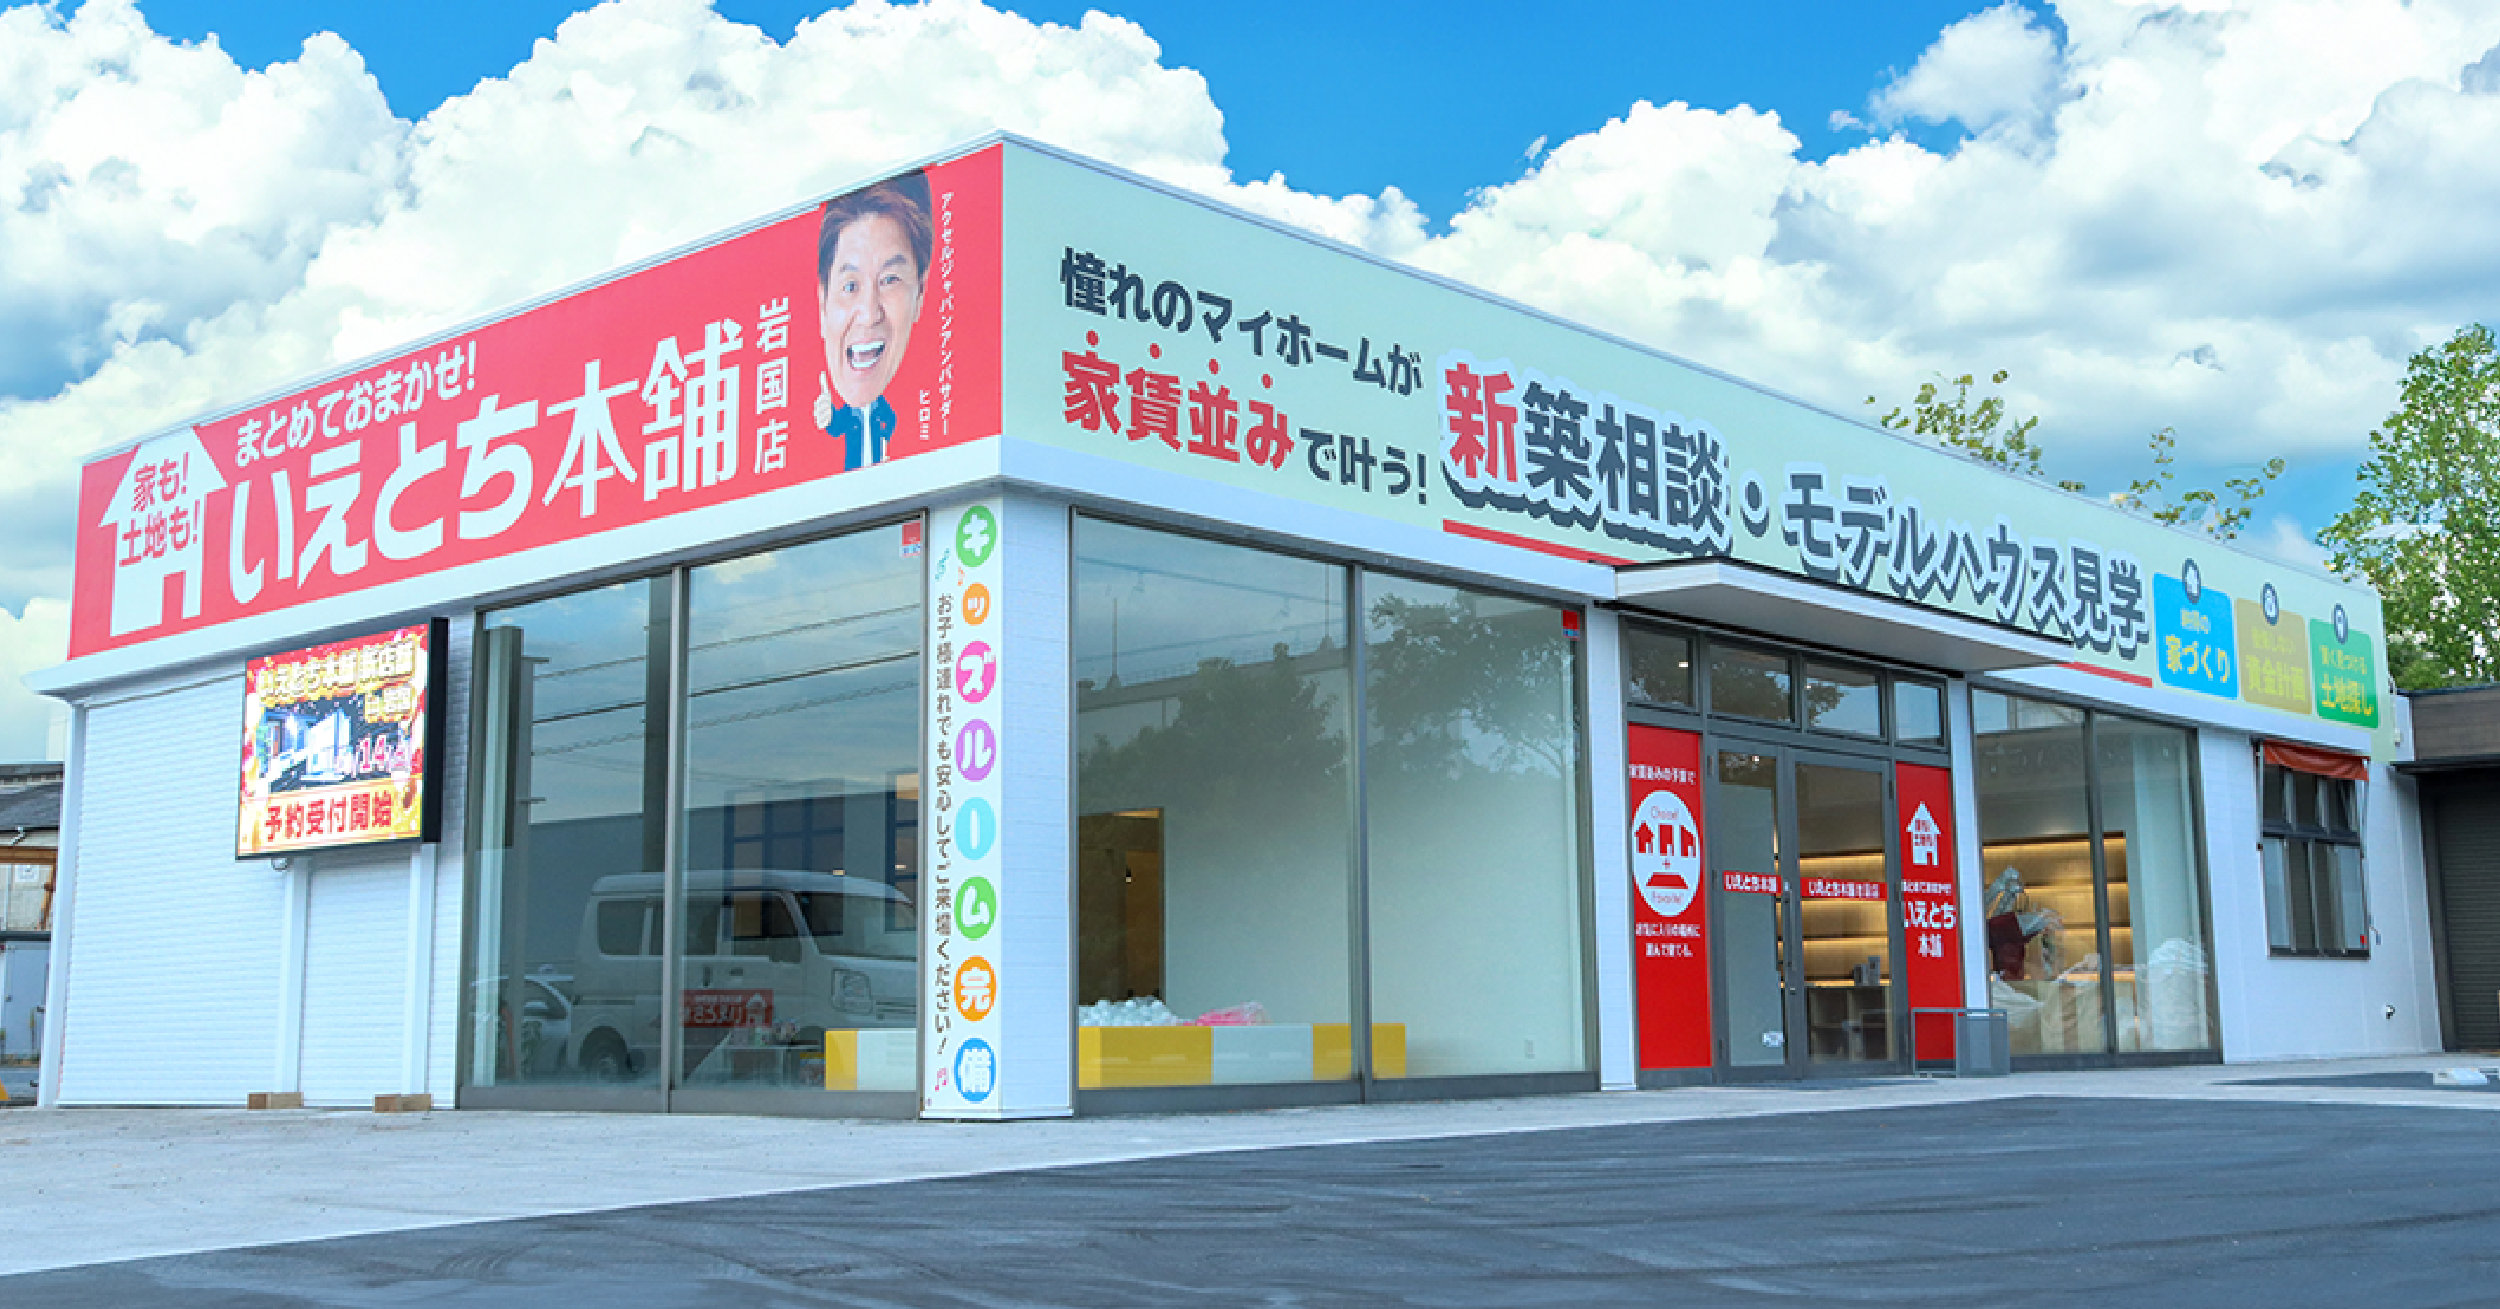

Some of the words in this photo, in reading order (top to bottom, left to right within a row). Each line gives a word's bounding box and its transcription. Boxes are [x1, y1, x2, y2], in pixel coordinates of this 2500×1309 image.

[1059, 245, 1423, 396] 憧れのマイホームが
[235, 339, 477, 467] まとめておまかせ!
[753, 296, 791, 475] 岩国店
[919, 389, 931, 440] ヒロミ
[1061, 349, 1428, 506] 家賃並みで叶う!
[131, 451, 190, 512] 家も!
[228, 318, 743, 605] いえとち本舗
[1443, 360, 2149, 654] 新築相談・モデルハウス見学
[118, 498, 200, 568] 土地も!
[2165, 634, 2231, 683] 家づくり
[2245, 653, 2307, 704] 資金計画
[2320, 673, 2374, 717] 土地探し
[264, 789, 393, 843] 予約受付開始
[958, 511, 995, 1094] キッズルーム完備
